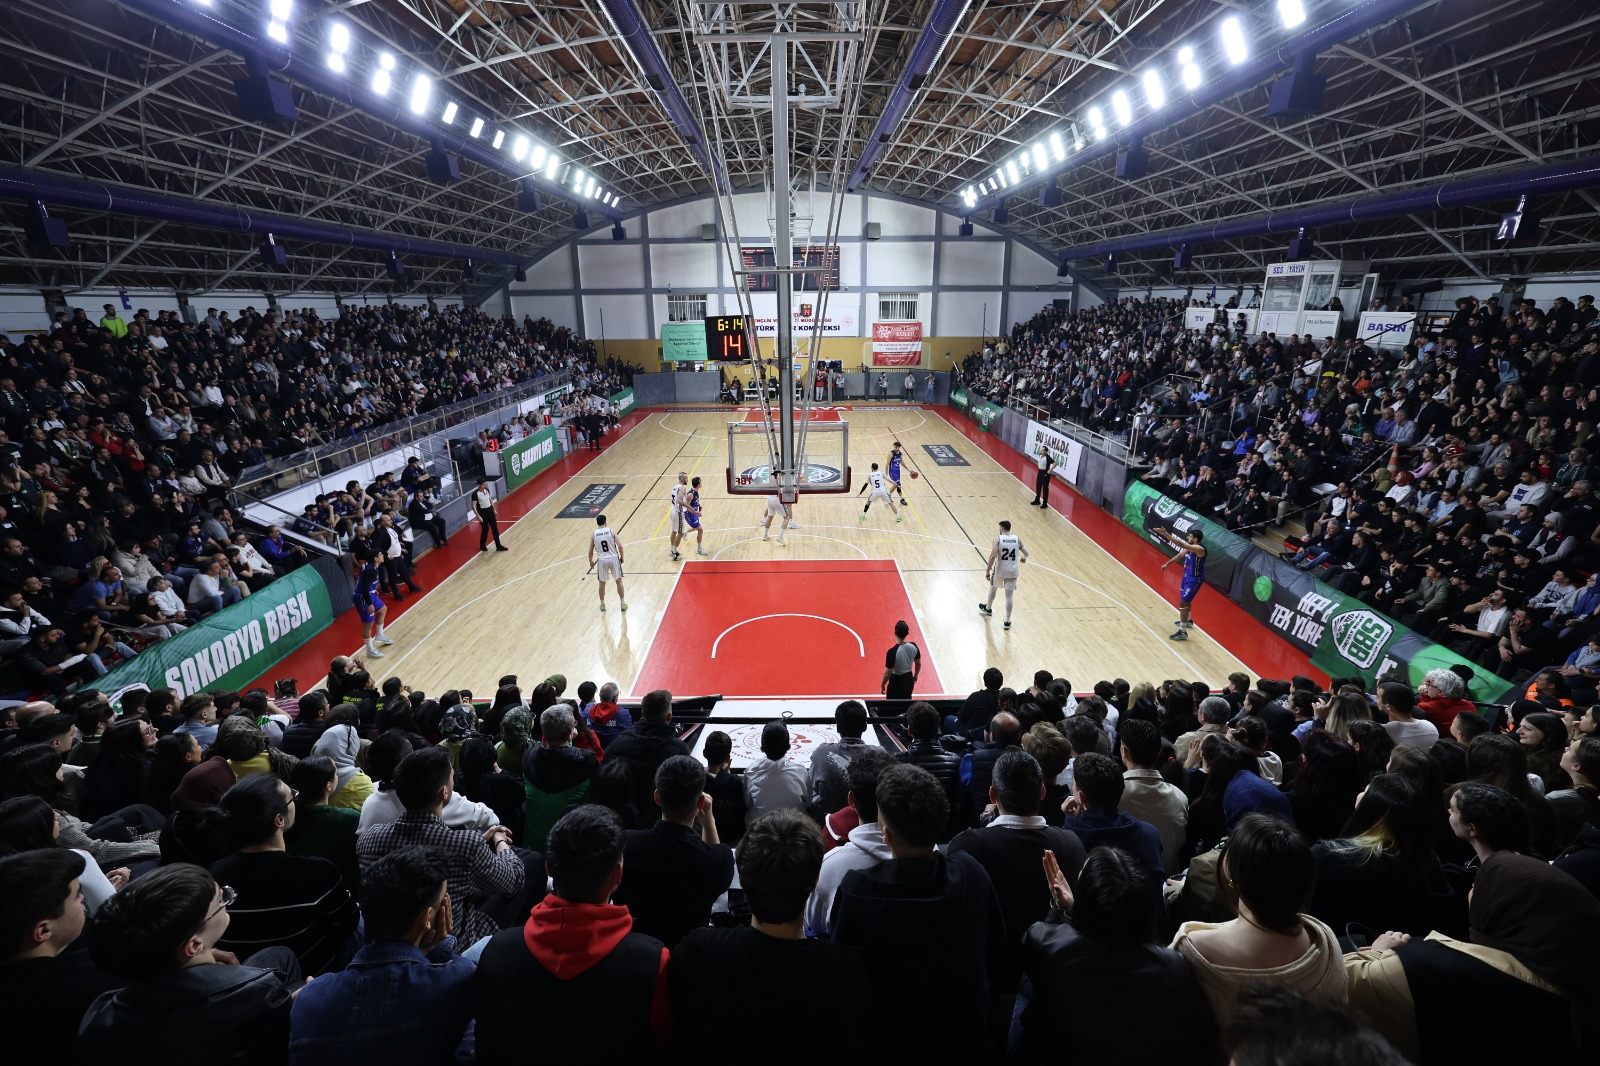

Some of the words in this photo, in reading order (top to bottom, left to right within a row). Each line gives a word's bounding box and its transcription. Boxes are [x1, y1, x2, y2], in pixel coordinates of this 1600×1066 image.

[1273, 266, 1284, 274] SES
[1289, 264, 1306, 273] YAYIN
[717, 318, 744, 331] 6:14
[1366, 322, 1407, 333] BASIN
[724, 334, 742, 356] 14
[1035, 430, 1045, 444] BU
[874, 479, 881, 489] 5
[600, 540, 610, 552] 8
[1001, 547, 1016, 561] 24
[1296, 591, 1332, 617] HEP
[1269, 603, 1295, 632] TEK
[1291, 614, 1325, 648] YÜRE
[1353, 615, 1365, 630] SPOR
[164, 619, 265, 701] SAKARYA
[263, 590, 312, 644] BBSK
[1347, 617, 1385, 663] SBB
